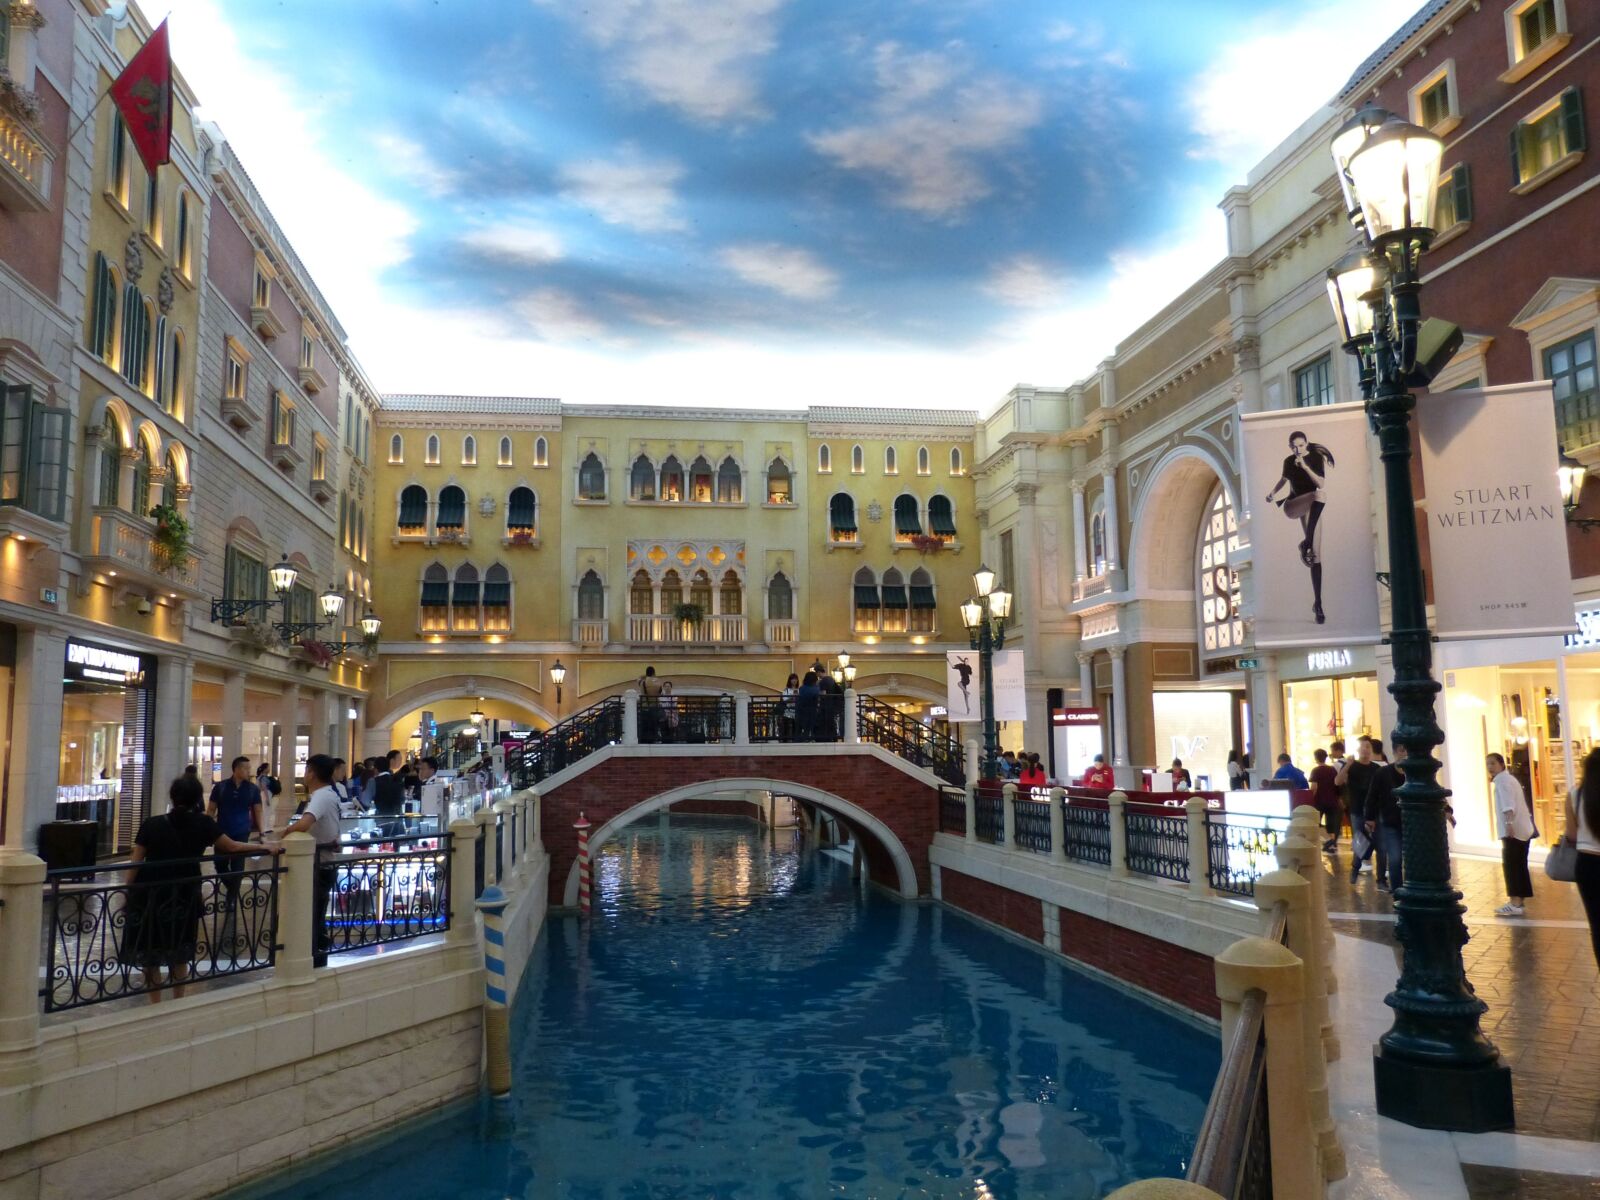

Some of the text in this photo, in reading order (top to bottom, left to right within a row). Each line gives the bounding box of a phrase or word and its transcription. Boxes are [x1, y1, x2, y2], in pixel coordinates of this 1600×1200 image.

[1454, 484, 1533, 506] STUART
[1437, 504, 1554, 529] WEITZMAN
[1307, 648, 1351, 671] FURLA
